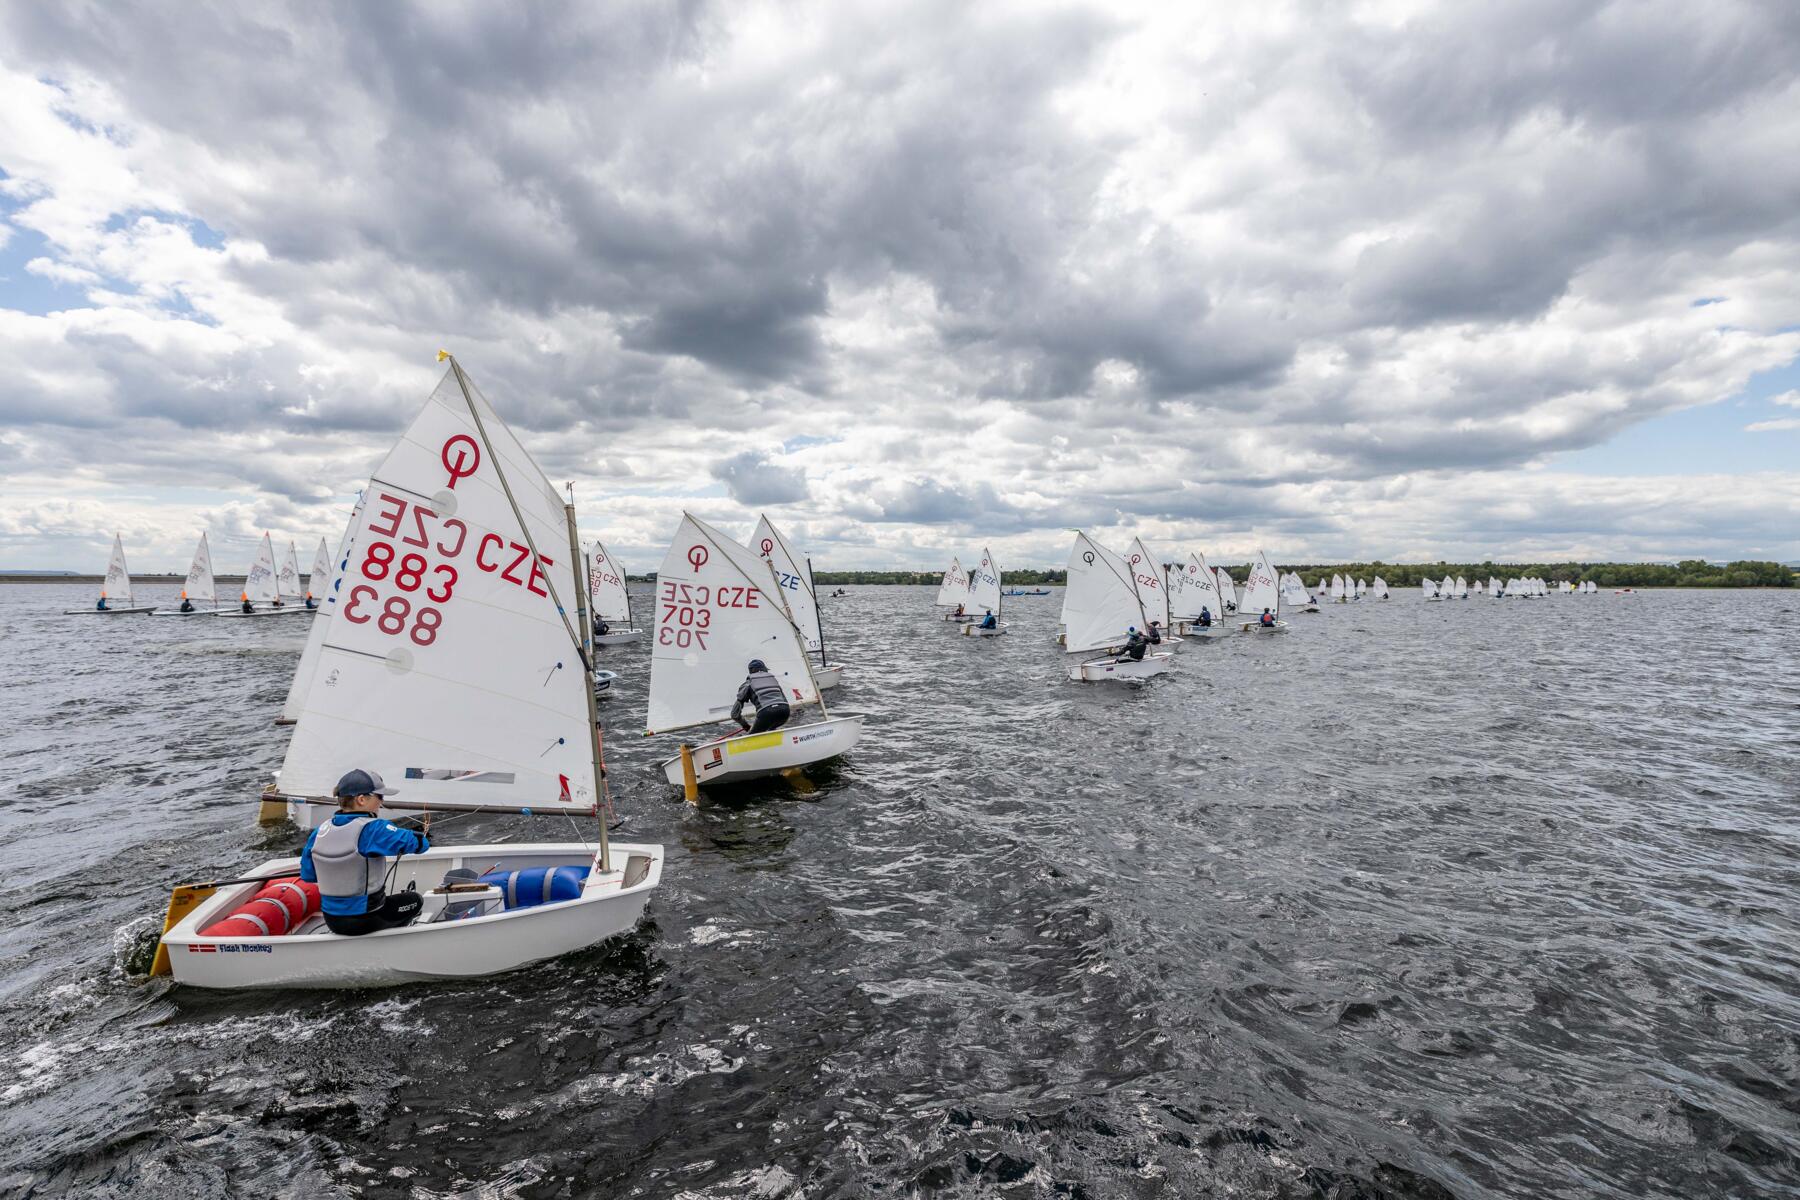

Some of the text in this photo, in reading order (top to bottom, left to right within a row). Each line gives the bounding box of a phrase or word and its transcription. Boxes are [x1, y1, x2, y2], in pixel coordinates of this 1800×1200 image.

[361, 541, 458, 603] 883
[476, 533, 554, 598] CZE
[603, 573, 619, 586] CZE
[775, 571, 800, 590] ZE
[1137, 574, 1158, 588] CZE
[1195, 580, 1212, 591] CZE
[1258, 576, 1272, 587] CZE
[717, 586, 761, 609] CZE
[662, 604, 711, 628] 703
